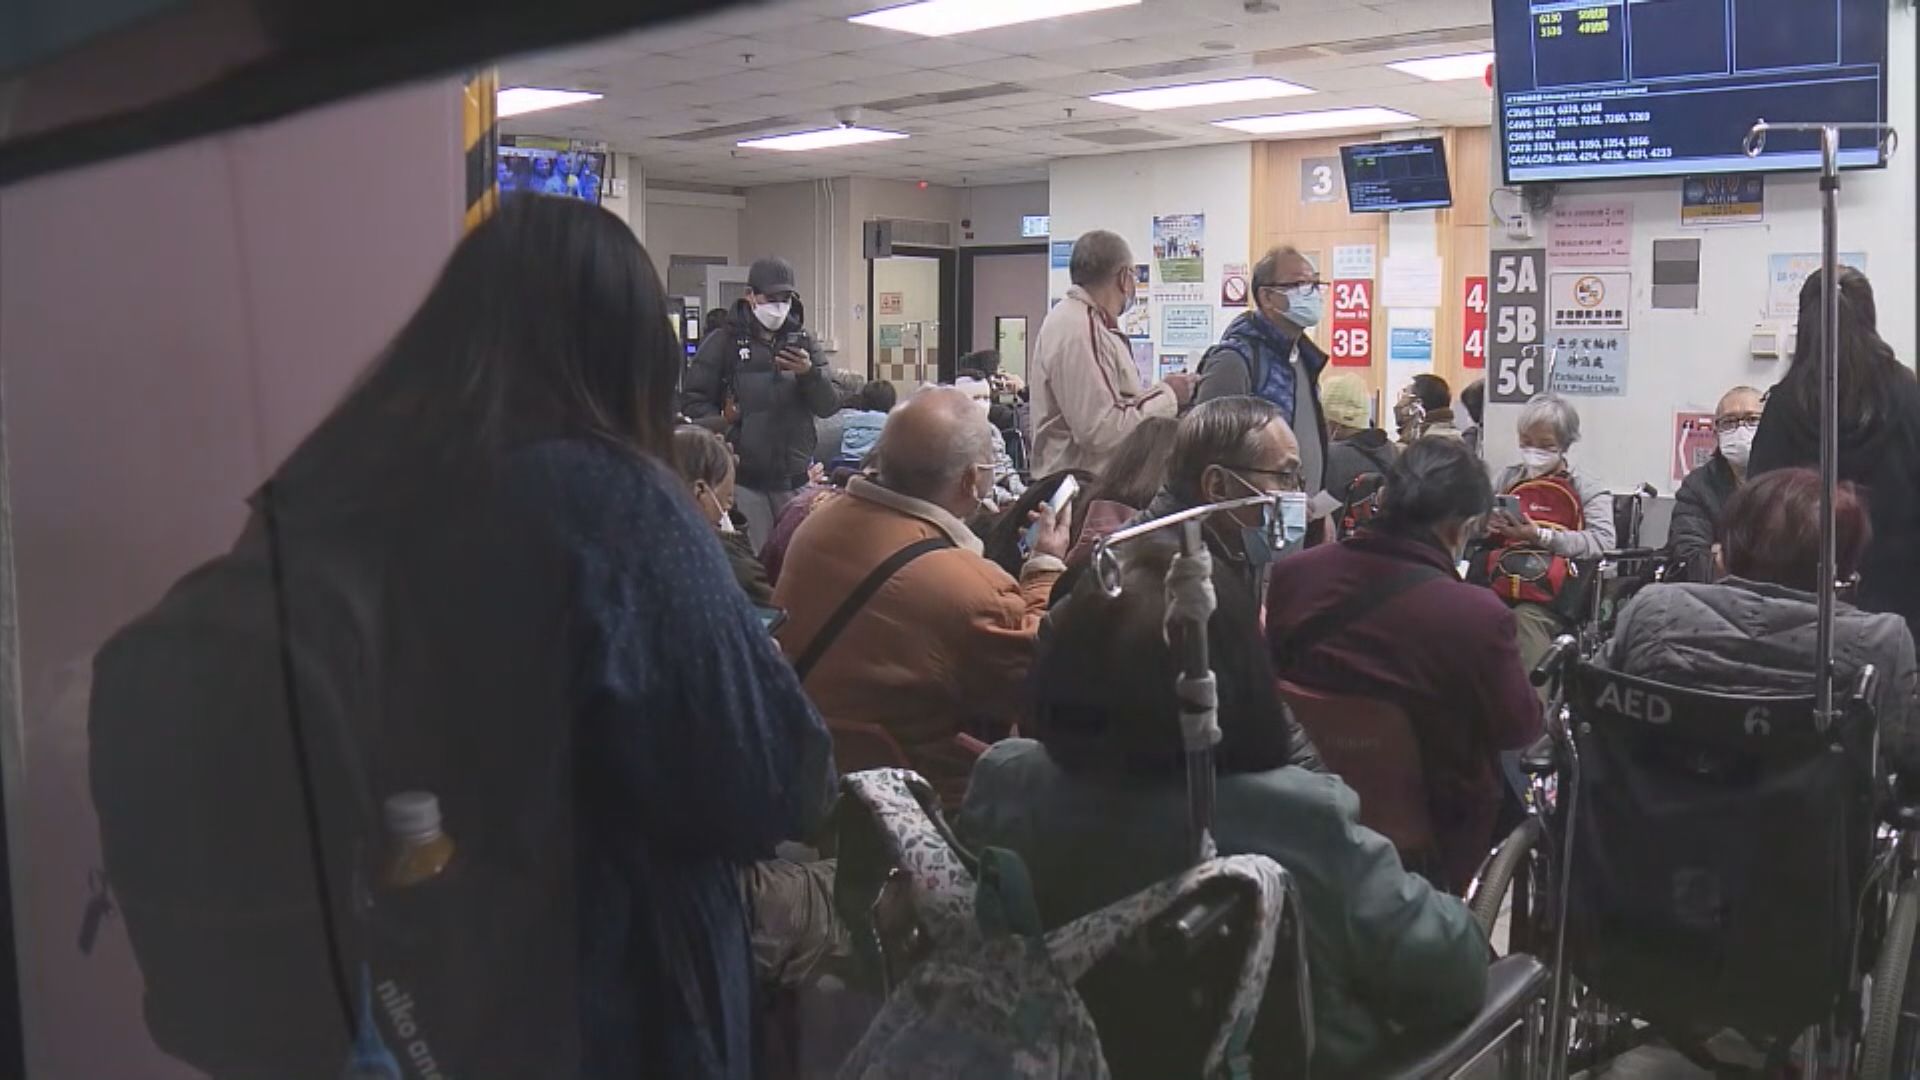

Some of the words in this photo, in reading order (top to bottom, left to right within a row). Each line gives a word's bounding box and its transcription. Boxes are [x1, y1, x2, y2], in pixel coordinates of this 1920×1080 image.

[1312, 166, 1332, 195] 3
[1497, 256, 1538, 293] 5A
[1335, 283, 1370, 310] 3A
[1467, 284, 1488, 313] 4
[1497, 306, 1536, 344] 5B
[1333, 329, 1369, 357] 3B
[1465, 329, 1487, 357] 4
[1497, 358, 1534, 395] 5C
[1596, 681, 1672, 724] AED
[1744, 705, 1771, 736] 6
[376, 979, 416, 1039] niko
